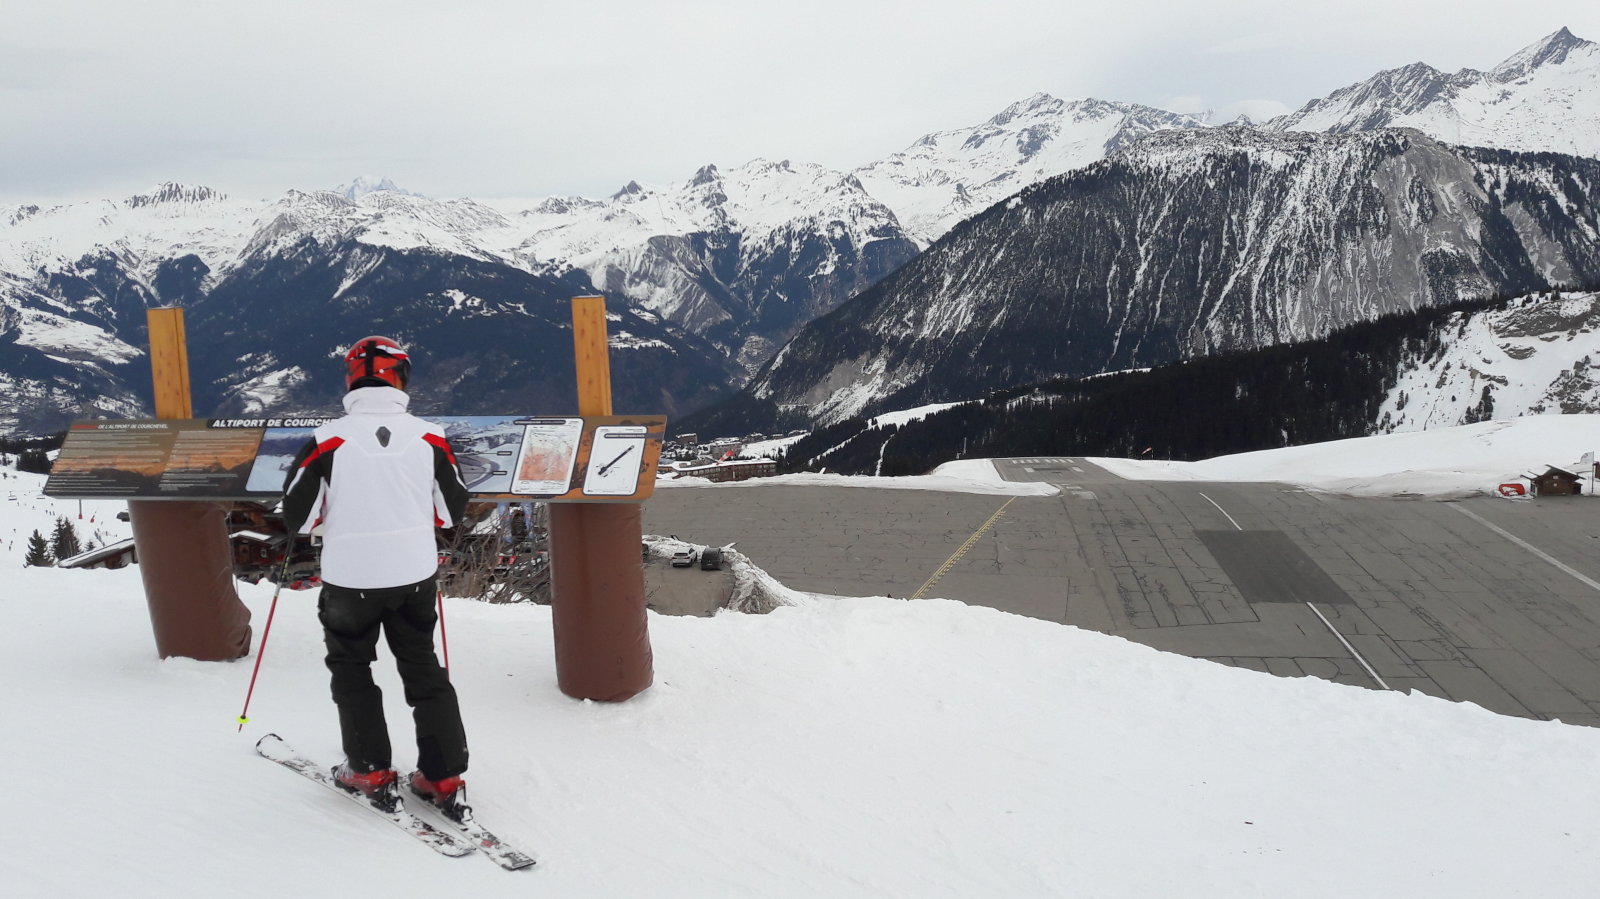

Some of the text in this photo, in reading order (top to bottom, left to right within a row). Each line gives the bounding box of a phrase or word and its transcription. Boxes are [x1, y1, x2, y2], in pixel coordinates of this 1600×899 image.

[212, 419, 332, 428] ALTIPORT DE COURCH
